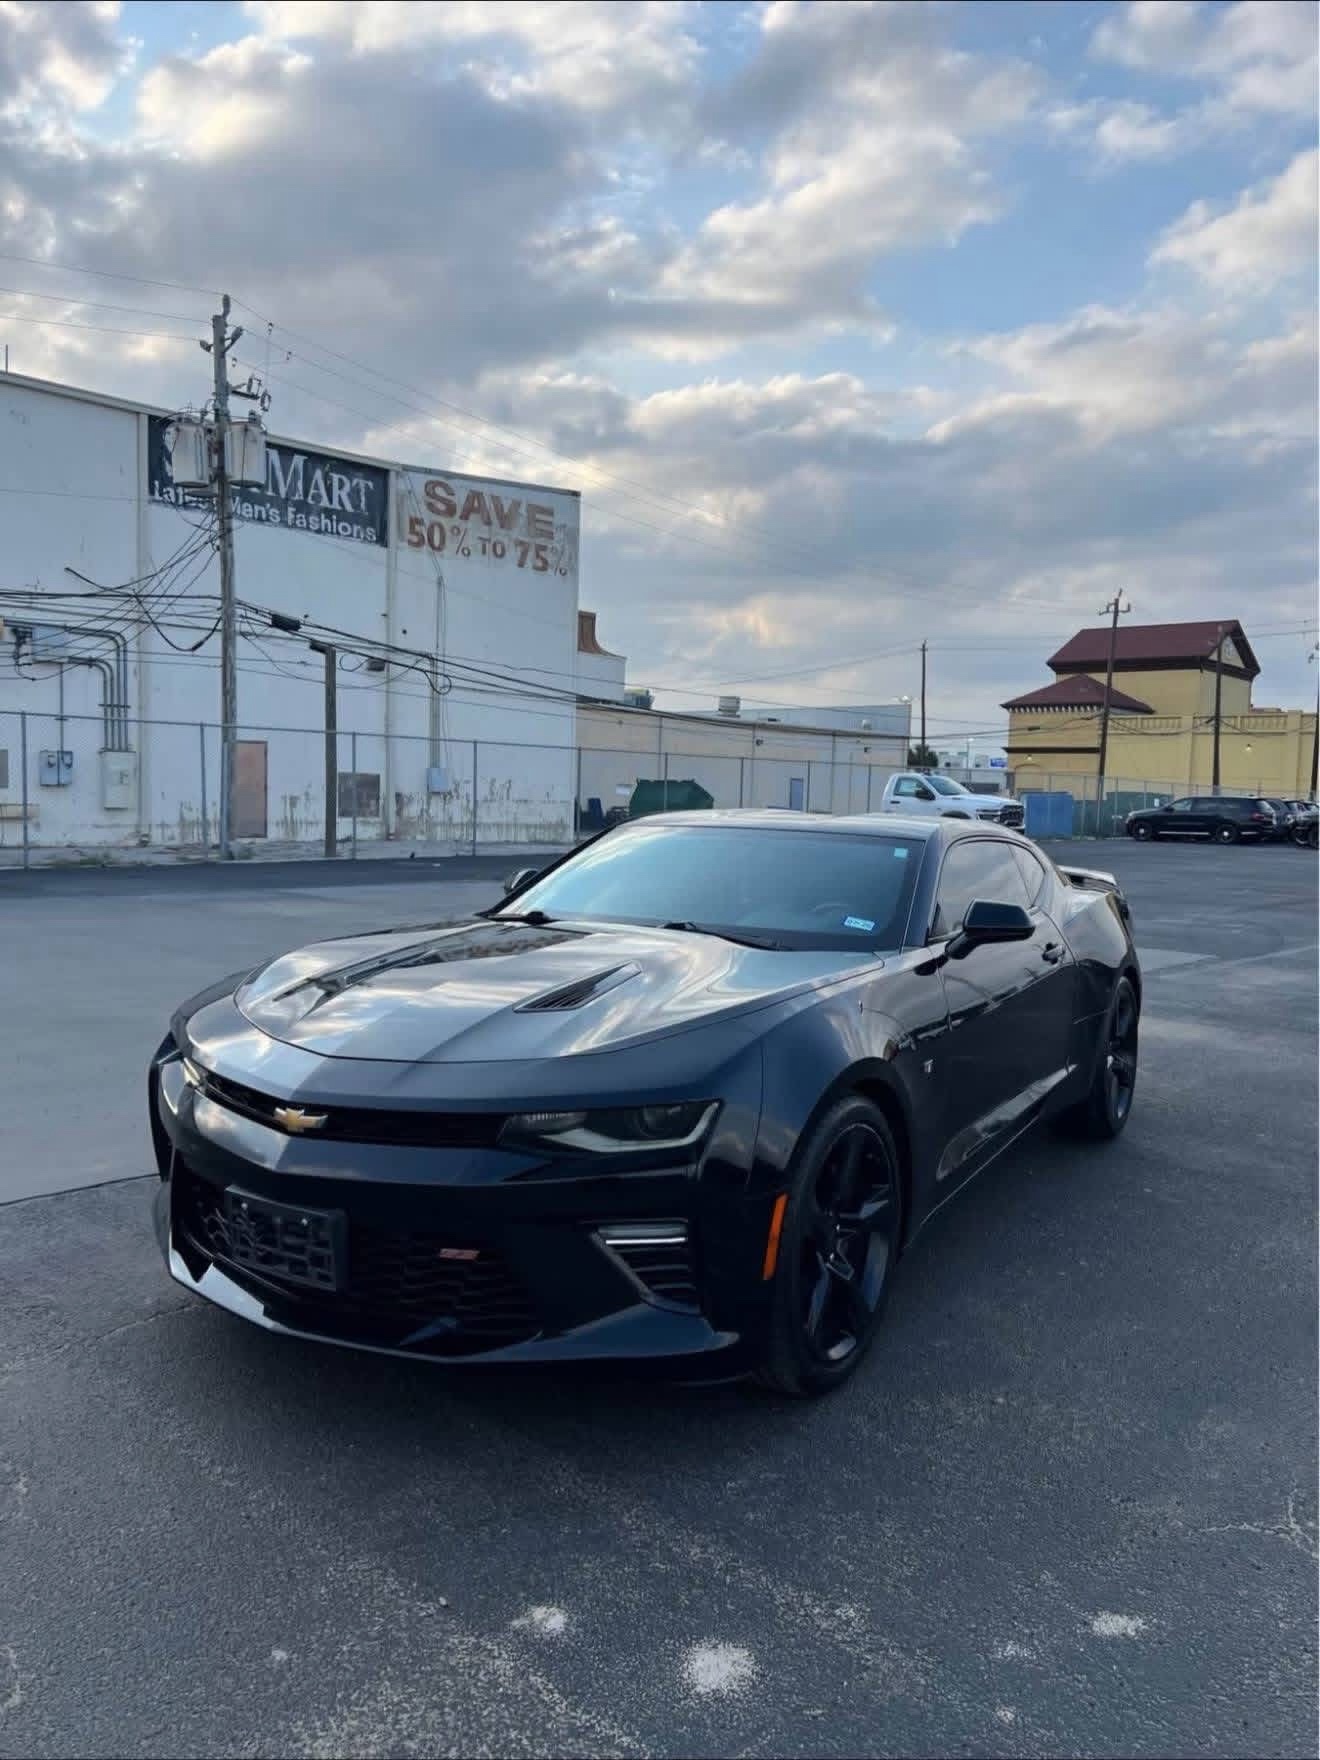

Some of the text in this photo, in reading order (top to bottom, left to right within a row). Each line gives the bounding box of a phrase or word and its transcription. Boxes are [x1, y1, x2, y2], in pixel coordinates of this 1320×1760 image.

[287, 505, 377, 542] Fashions
[424, 479, 555, 541] SAVE
[407, 515, 568, 577] 50% TO 75%
